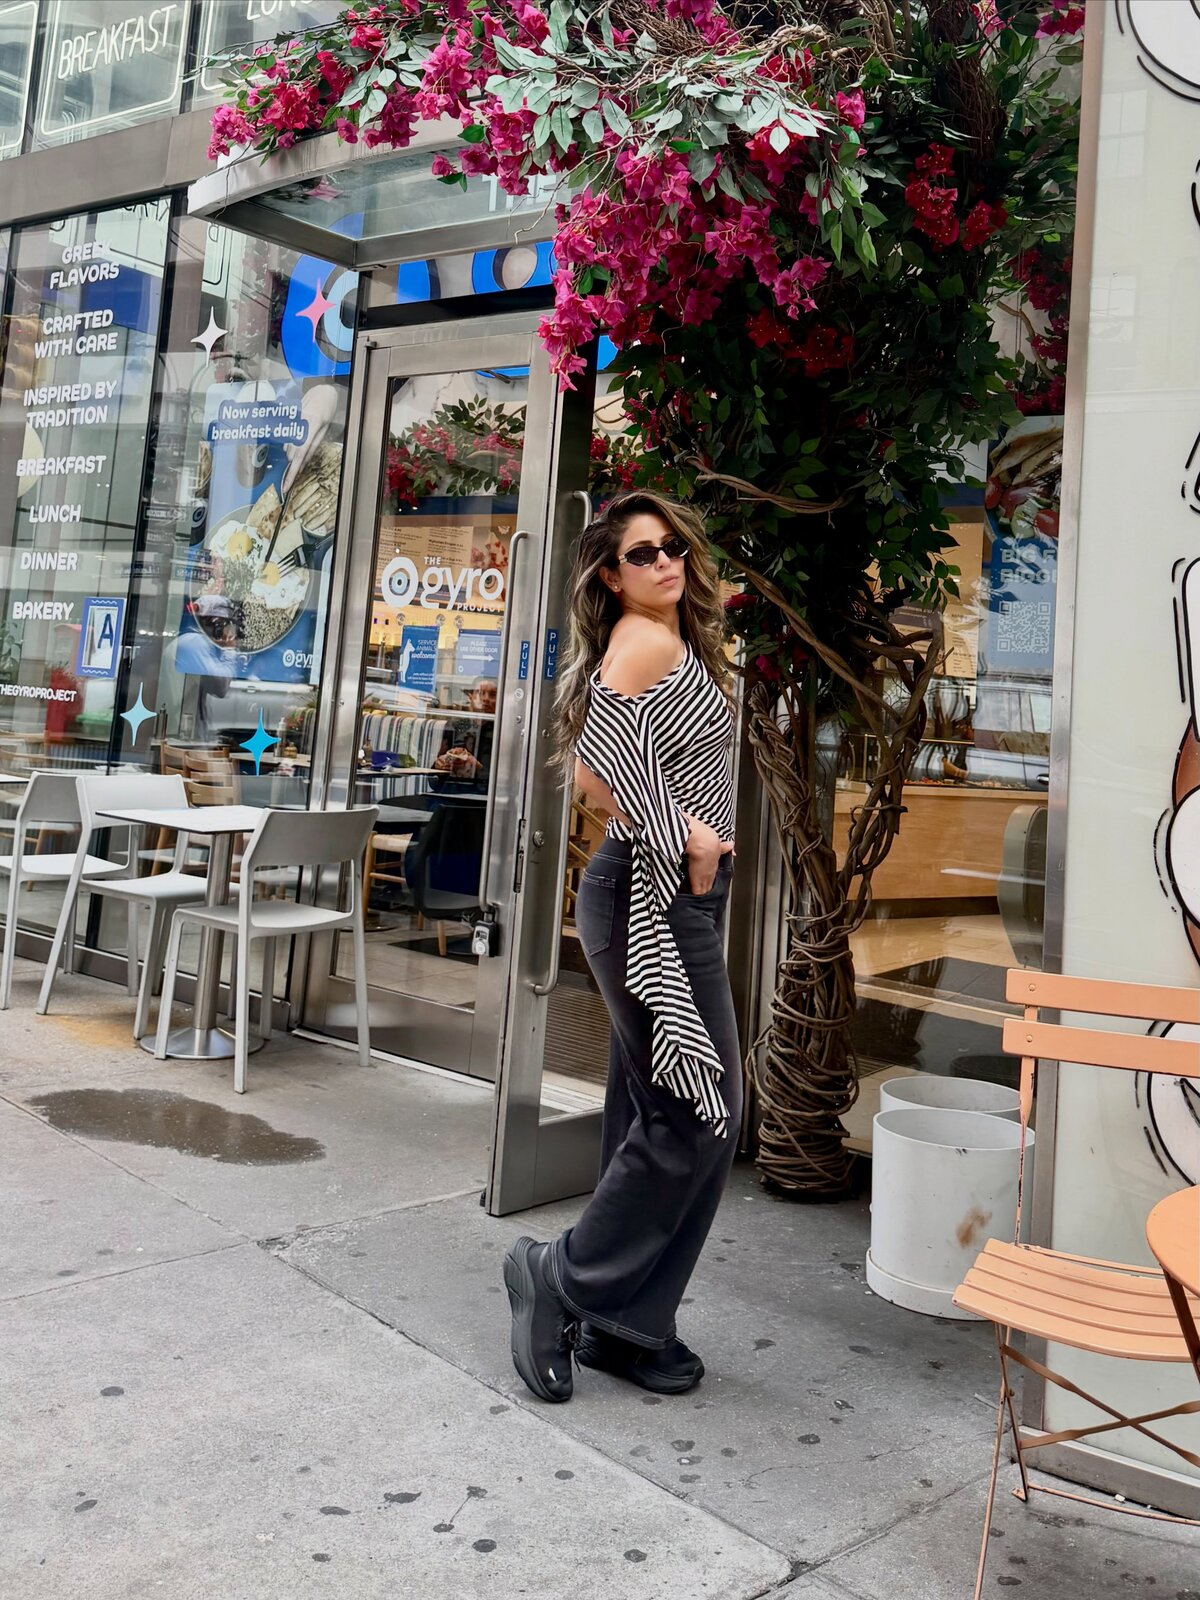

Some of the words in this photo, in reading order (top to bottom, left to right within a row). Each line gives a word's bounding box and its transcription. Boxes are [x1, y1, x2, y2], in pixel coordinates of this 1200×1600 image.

[58, 4, 177, 79] BREAKFAST
[62, 241, 112, 264] GREEK
[49, 261, 120, 290] FLAVORS
[43, 309, 113, 335] CRAFTED
[35, 337, 73, 359] WITH
[75, 332, 118, 354] CARE
[23, 383, 92, 407] INSPIRED
[94, 380, 117, 399] BY
[26, 405, 108, 429] TRADITION
[222, 406, 250, 420] Now
[252, 402, 298, 420] serving
[211, 424, 271, 440] breakfast
[273, 422, 305, 440] daily
[16, 455, 107, 477] BREAKFAST
[29, 504, 82, 523] LUNCH
[20, 552, 78, 571] DINNER
[424, 556, 442, 566] THE
[420, 566, 504, 611] gyro
[12, 601, 75, 620] BAKERY
[456, 602, 502, 613] PROJECT
[97, 613, 114, 649] A
[520, 643, 529, 678] PULL
[547, 632, 557, 678] PULL
